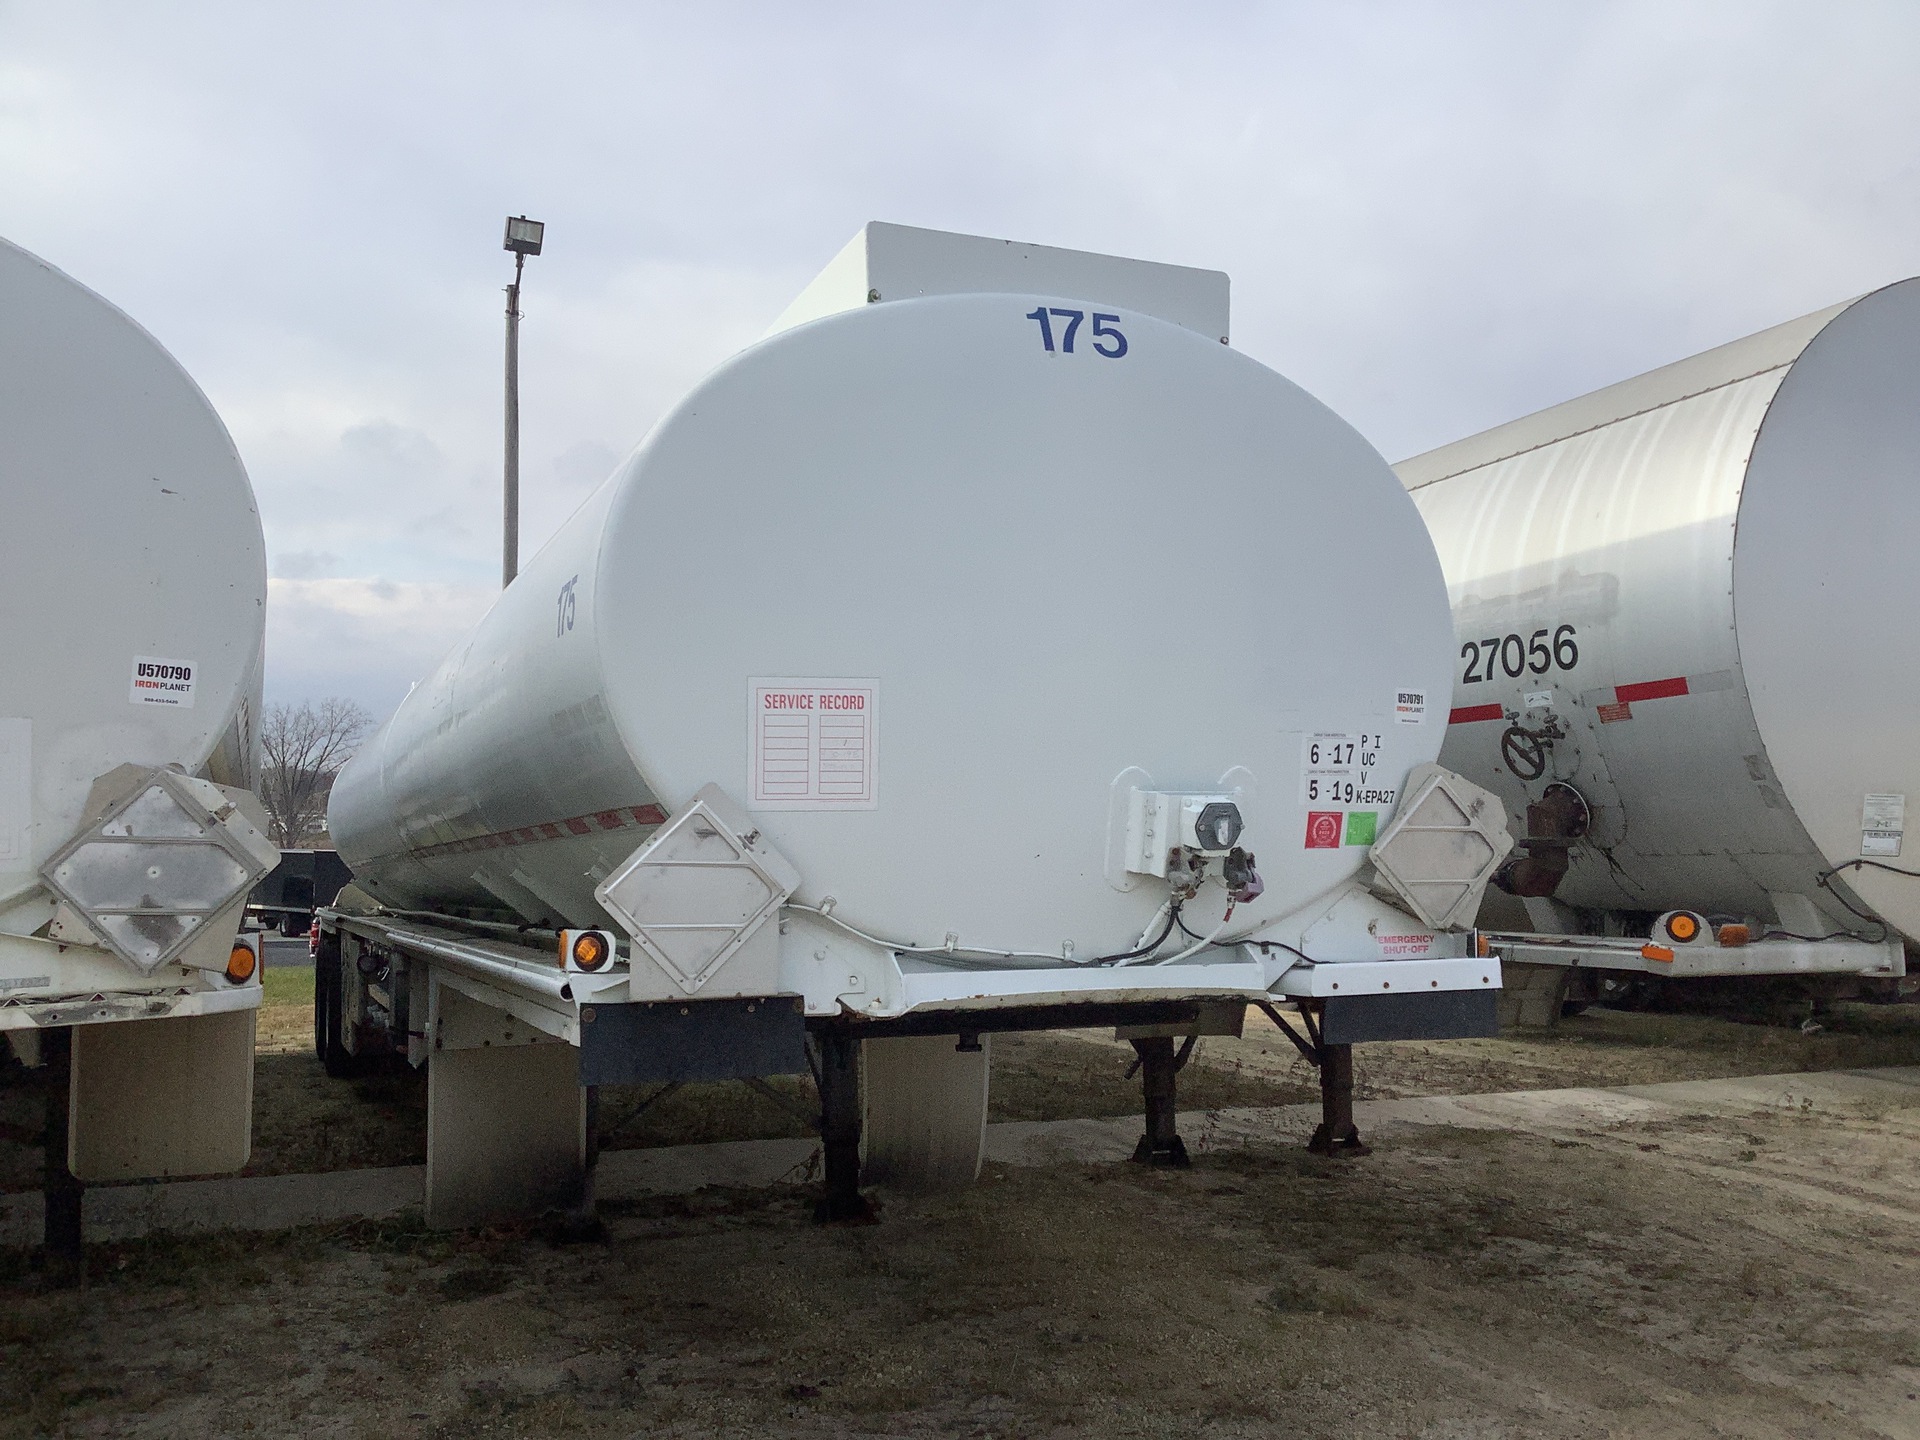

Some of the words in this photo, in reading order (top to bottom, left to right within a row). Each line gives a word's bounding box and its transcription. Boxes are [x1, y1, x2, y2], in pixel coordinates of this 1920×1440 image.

[1026, 307, 1128, 358] 175
[557, 574, 578, 638] 175
[1461, 624, 1579, 684] 27056
[138, 663, 191, 681] U570790
[764, 694, 814, 709] SERVICE
[819, 694, 865, 710] RECORD
[1398, 693, 1424, 705] U570791
[1361, 734, 1368, 749] P
[1361, 752, 1376, 766] UC
[1361, 771, 1367, 784] V
[1356, 789, 1395, 804] K-EPA27
[1378, 934, 1435, 944] EMERGENCY
[1383, 945, 1429, 954] SHUT-OFF
